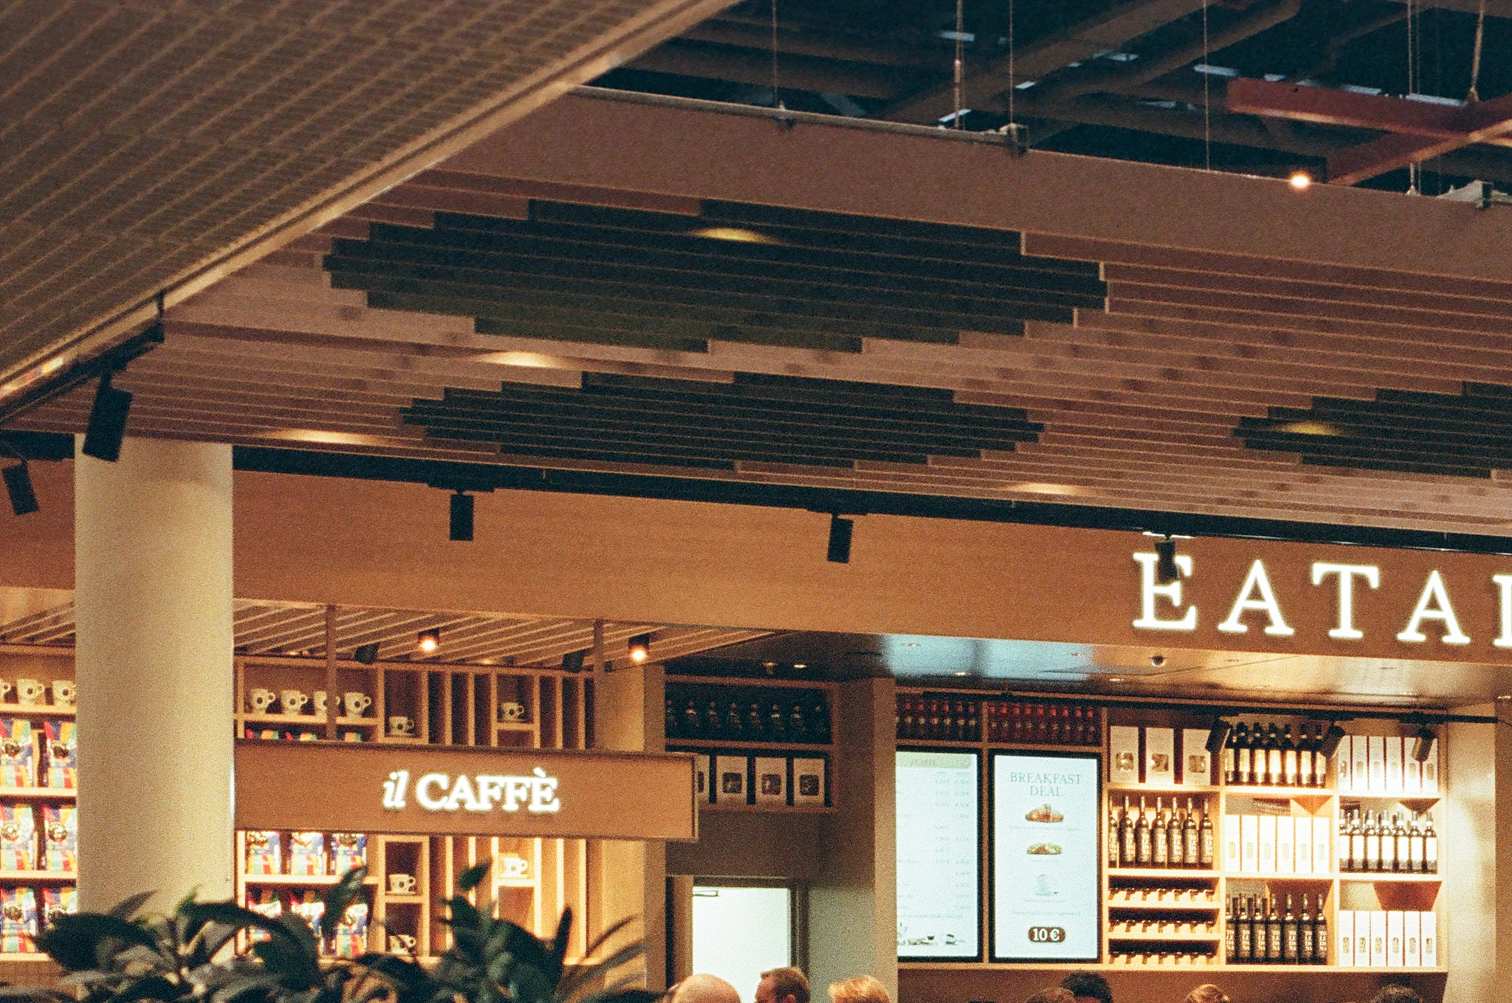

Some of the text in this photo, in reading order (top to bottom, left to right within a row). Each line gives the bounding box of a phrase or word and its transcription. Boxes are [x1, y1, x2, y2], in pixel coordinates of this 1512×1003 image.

[1009, 771, 1083, 785] BREAKFAST
[383, 766, 561, 813] il CAFFÈ
[1029, 785, 1063, 797] DEAL
[1032, 928, 1060, 941] 10 €
